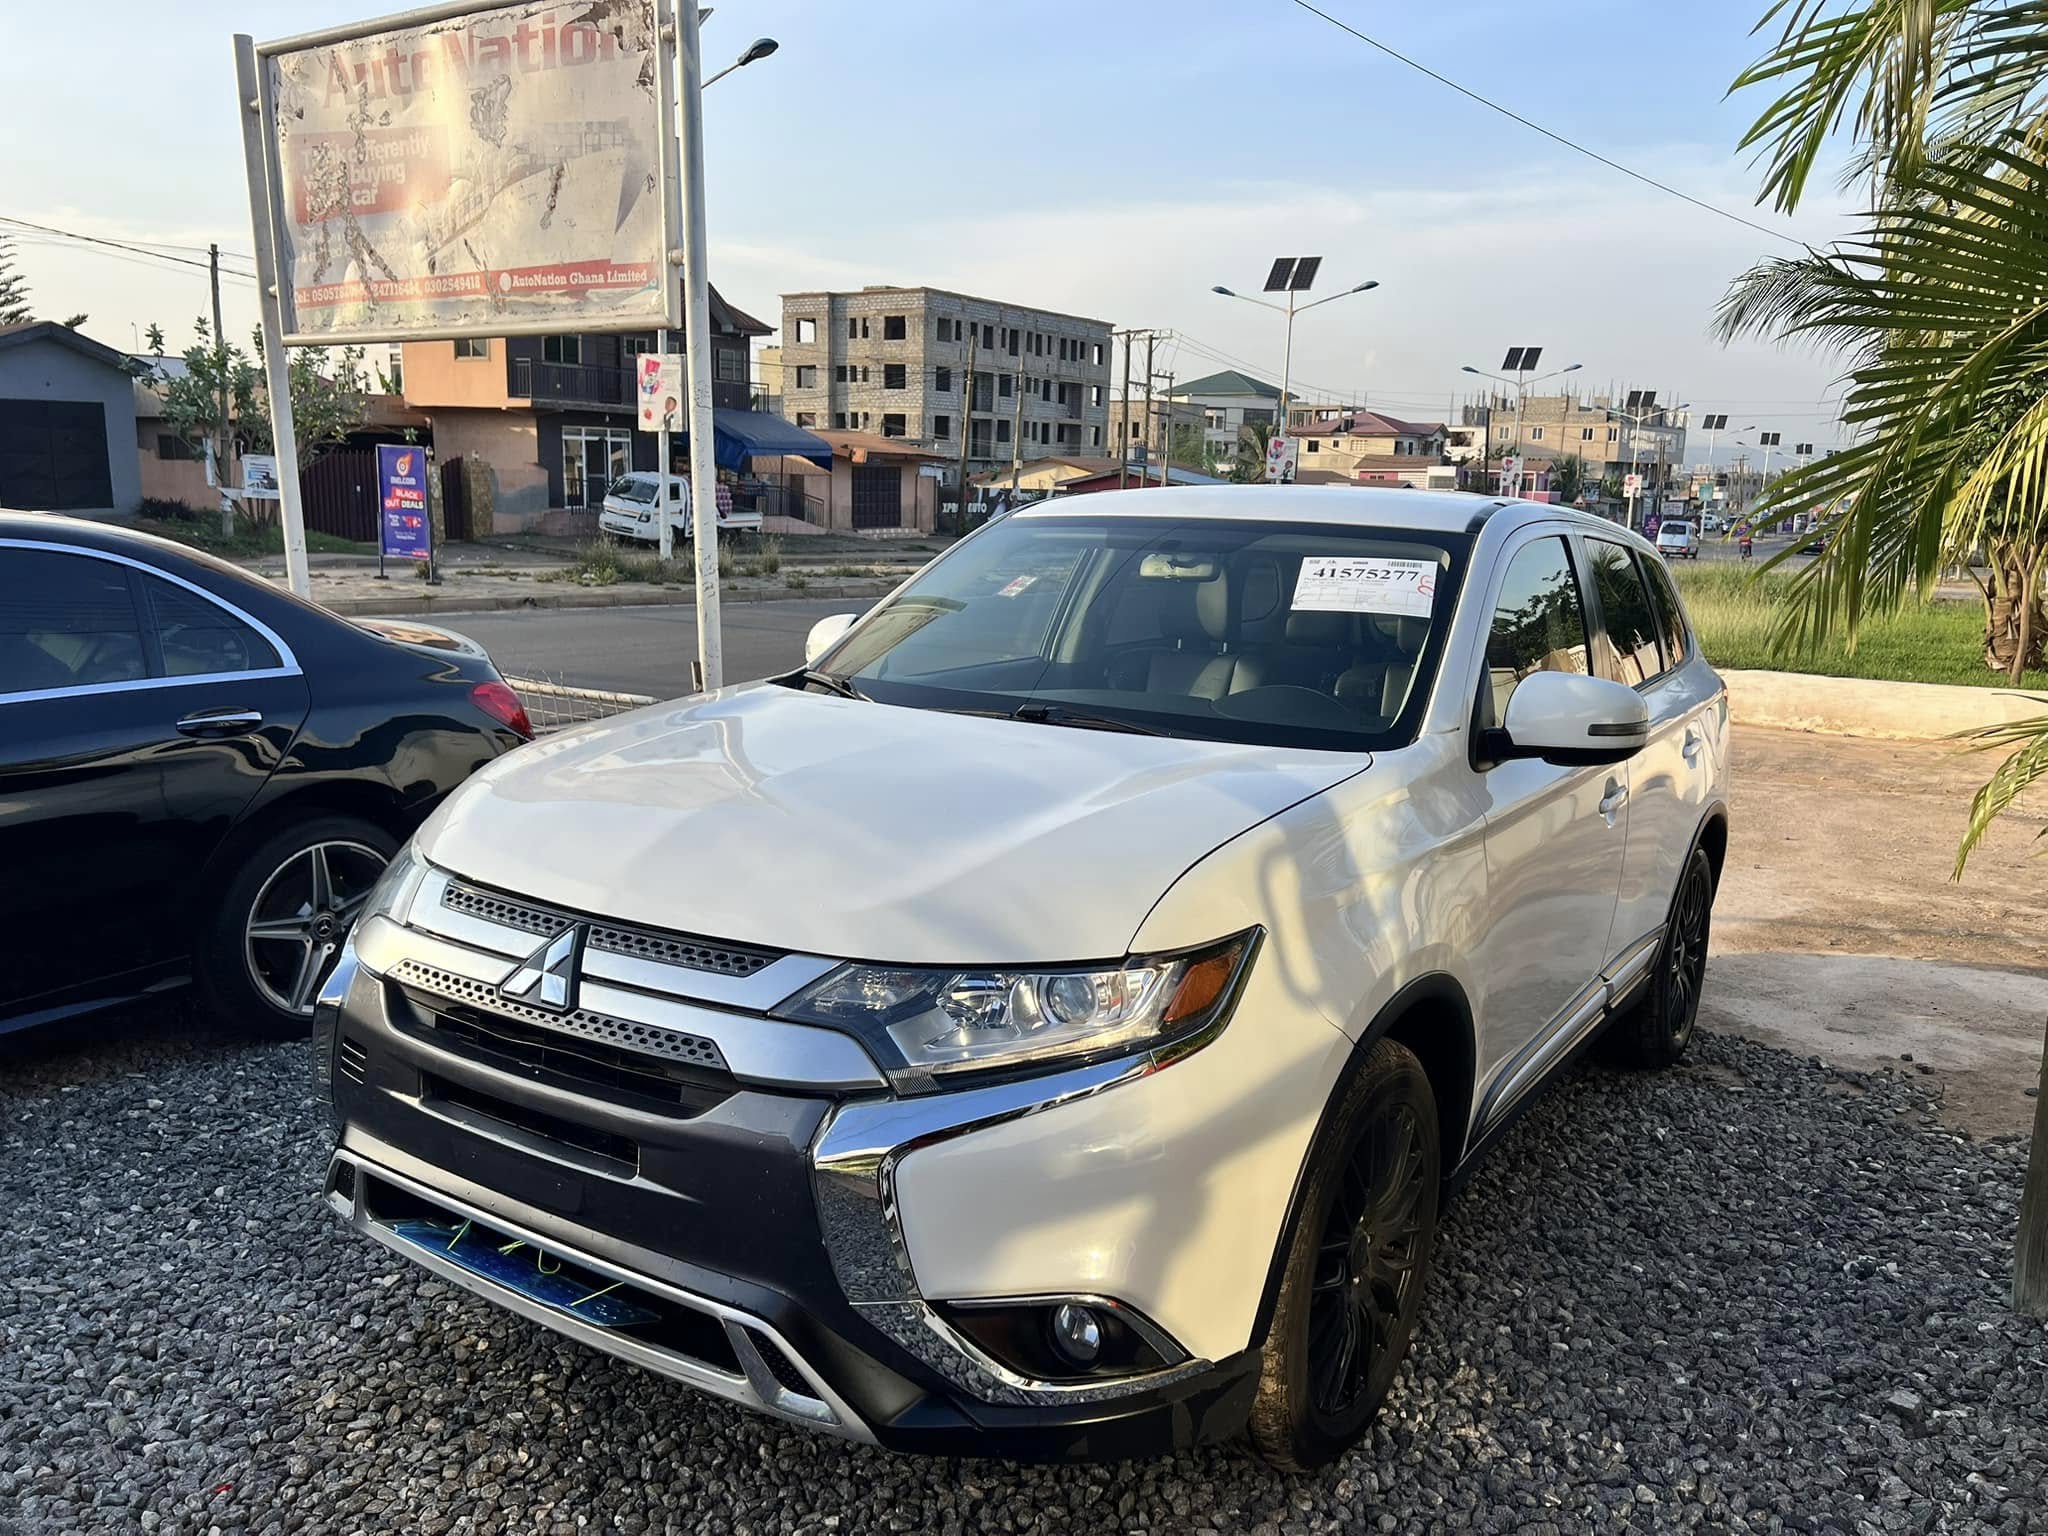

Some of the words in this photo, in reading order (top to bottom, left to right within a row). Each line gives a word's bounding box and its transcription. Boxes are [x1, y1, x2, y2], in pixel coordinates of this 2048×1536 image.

[351, 188, 379, 206] car
[512, 273, 567, 288] AutoNation
[569, 272, 605, 284] Ghana
[607, 269, 648, 283] Limited
[401, 500, 424, 509] DEALS
[1312, 567, 1420, 582] 41575277
